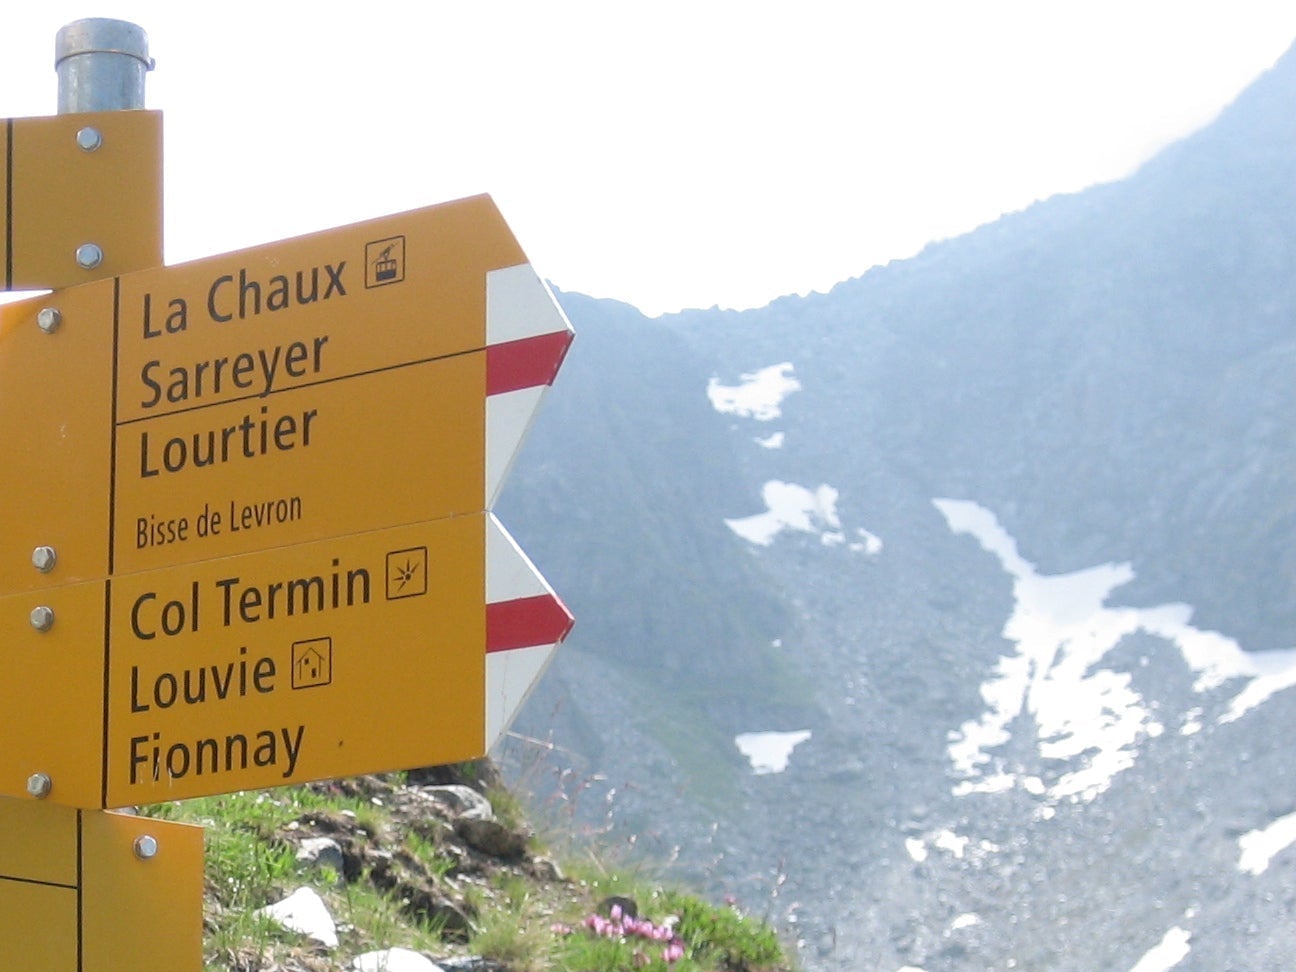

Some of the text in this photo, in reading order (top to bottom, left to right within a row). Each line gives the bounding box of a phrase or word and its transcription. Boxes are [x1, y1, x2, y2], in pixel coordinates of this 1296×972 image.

[142, 260, 348, 340] La Chaux
[140, 333, 330, 408] Sarreyer
[140, 406, 319, 479] Lourtier
[136, 494, 302, 549] Bisse de Levron
[130, 558, 371, 641] Col Termin
[130, 647, 277, 713] Louvie
[129, 725, 305, 785] Fionnay
